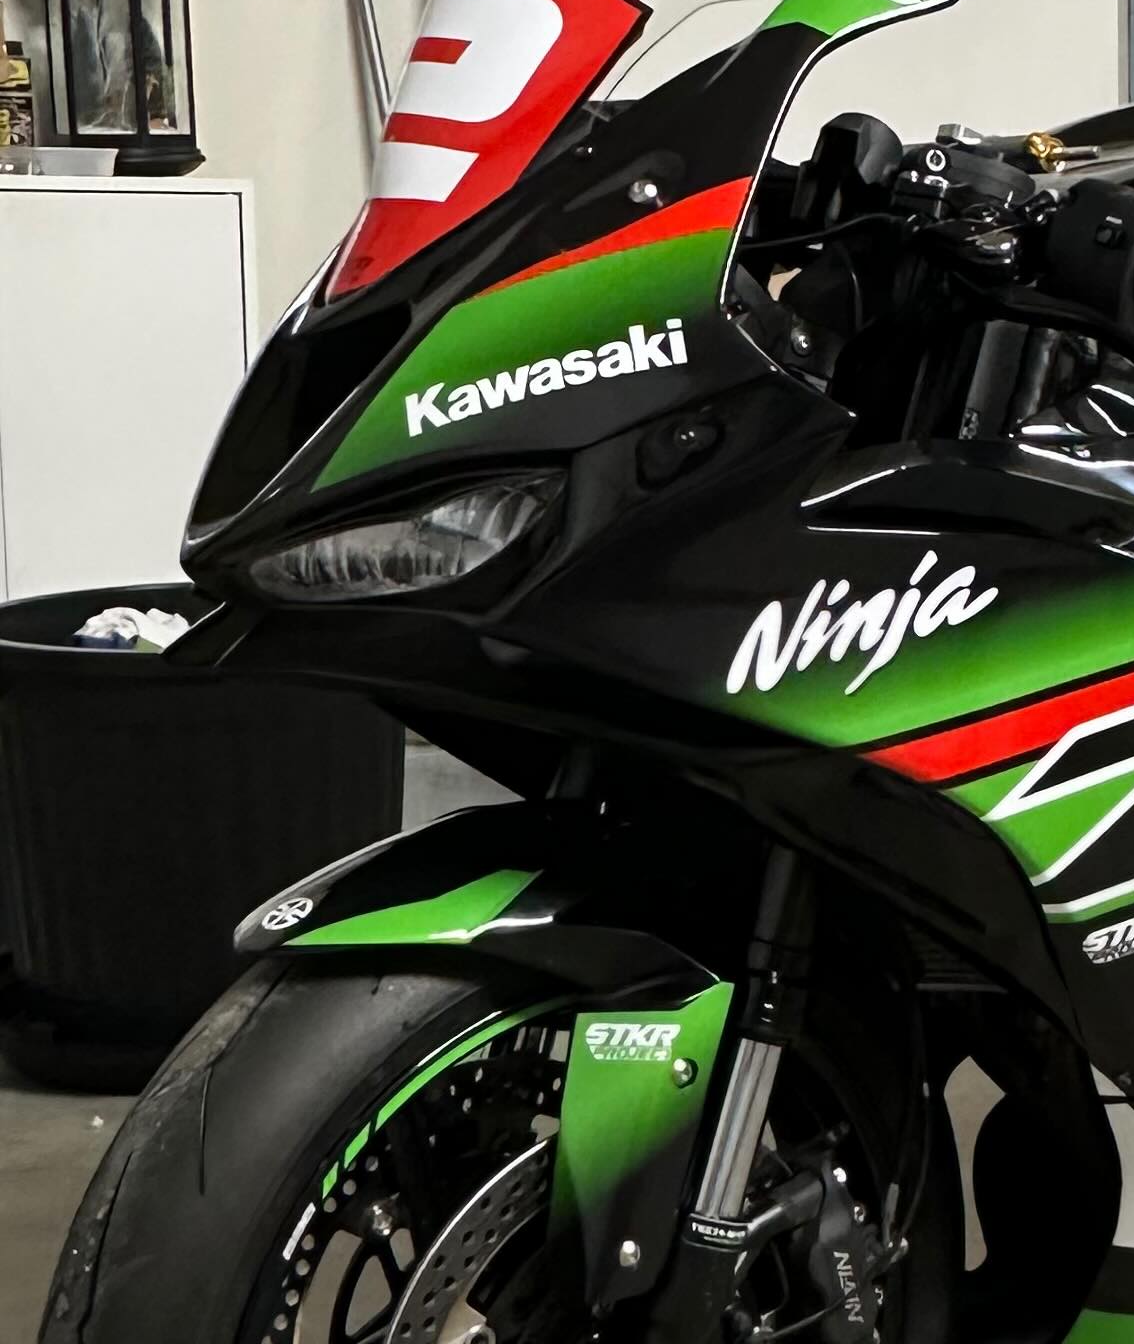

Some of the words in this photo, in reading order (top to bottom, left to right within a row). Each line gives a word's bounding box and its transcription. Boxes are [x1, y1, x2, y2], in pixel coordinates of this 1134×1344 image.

[404, 317, 689, 438] Kawasaki
[725, 549, 1000, 696] Ninja
[585, 1022, 681, 1046] STKR
